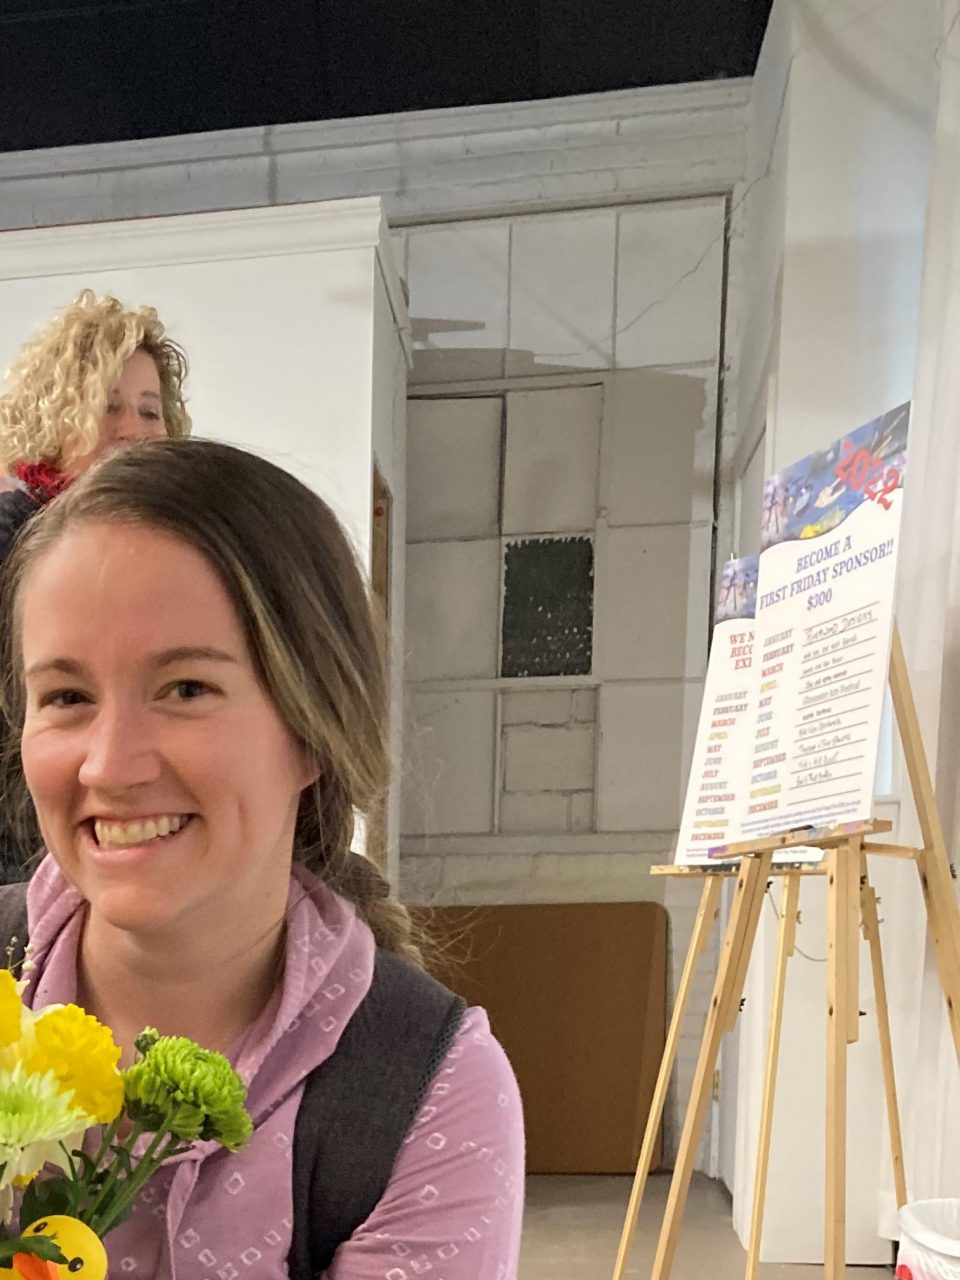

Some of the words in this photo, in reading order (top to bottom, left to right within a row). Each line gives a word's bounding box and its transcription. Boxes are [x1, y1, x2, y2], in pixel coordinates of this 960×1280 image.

[796, 541, 841, 574] BECOME
[842, 535, 853, 552] A
[759, 585, 788, 610] FIRST
[790, 567, 830, 597] FRIDAY
[831, 539, 895, 580] SPONSOR!!
[806, 588, 833, 611] $300
[729, 632, 746, 645] WE
[763, 628, 793, 647] JANUARY
[762, 643, 794, 662] FEBRUARY
[761, 662, 783, 678] MARCH
[715, 691, 748, 703] JANUARY
[758, 696, 772, 708] MAY
[713, 703, 748, 716] FEBRUARY
[711, 718, 736, 728] MARCH
[757, 711, 773, 724] JUNE
[755, 727, 771, 739] JULY
[706, 744, 723, 753] MAY
[752, 752, 786, 769] SEPTEMBER
[702, 770, 720, 779] JULY
[697, 793, 736, 804] SEPTEMBER
